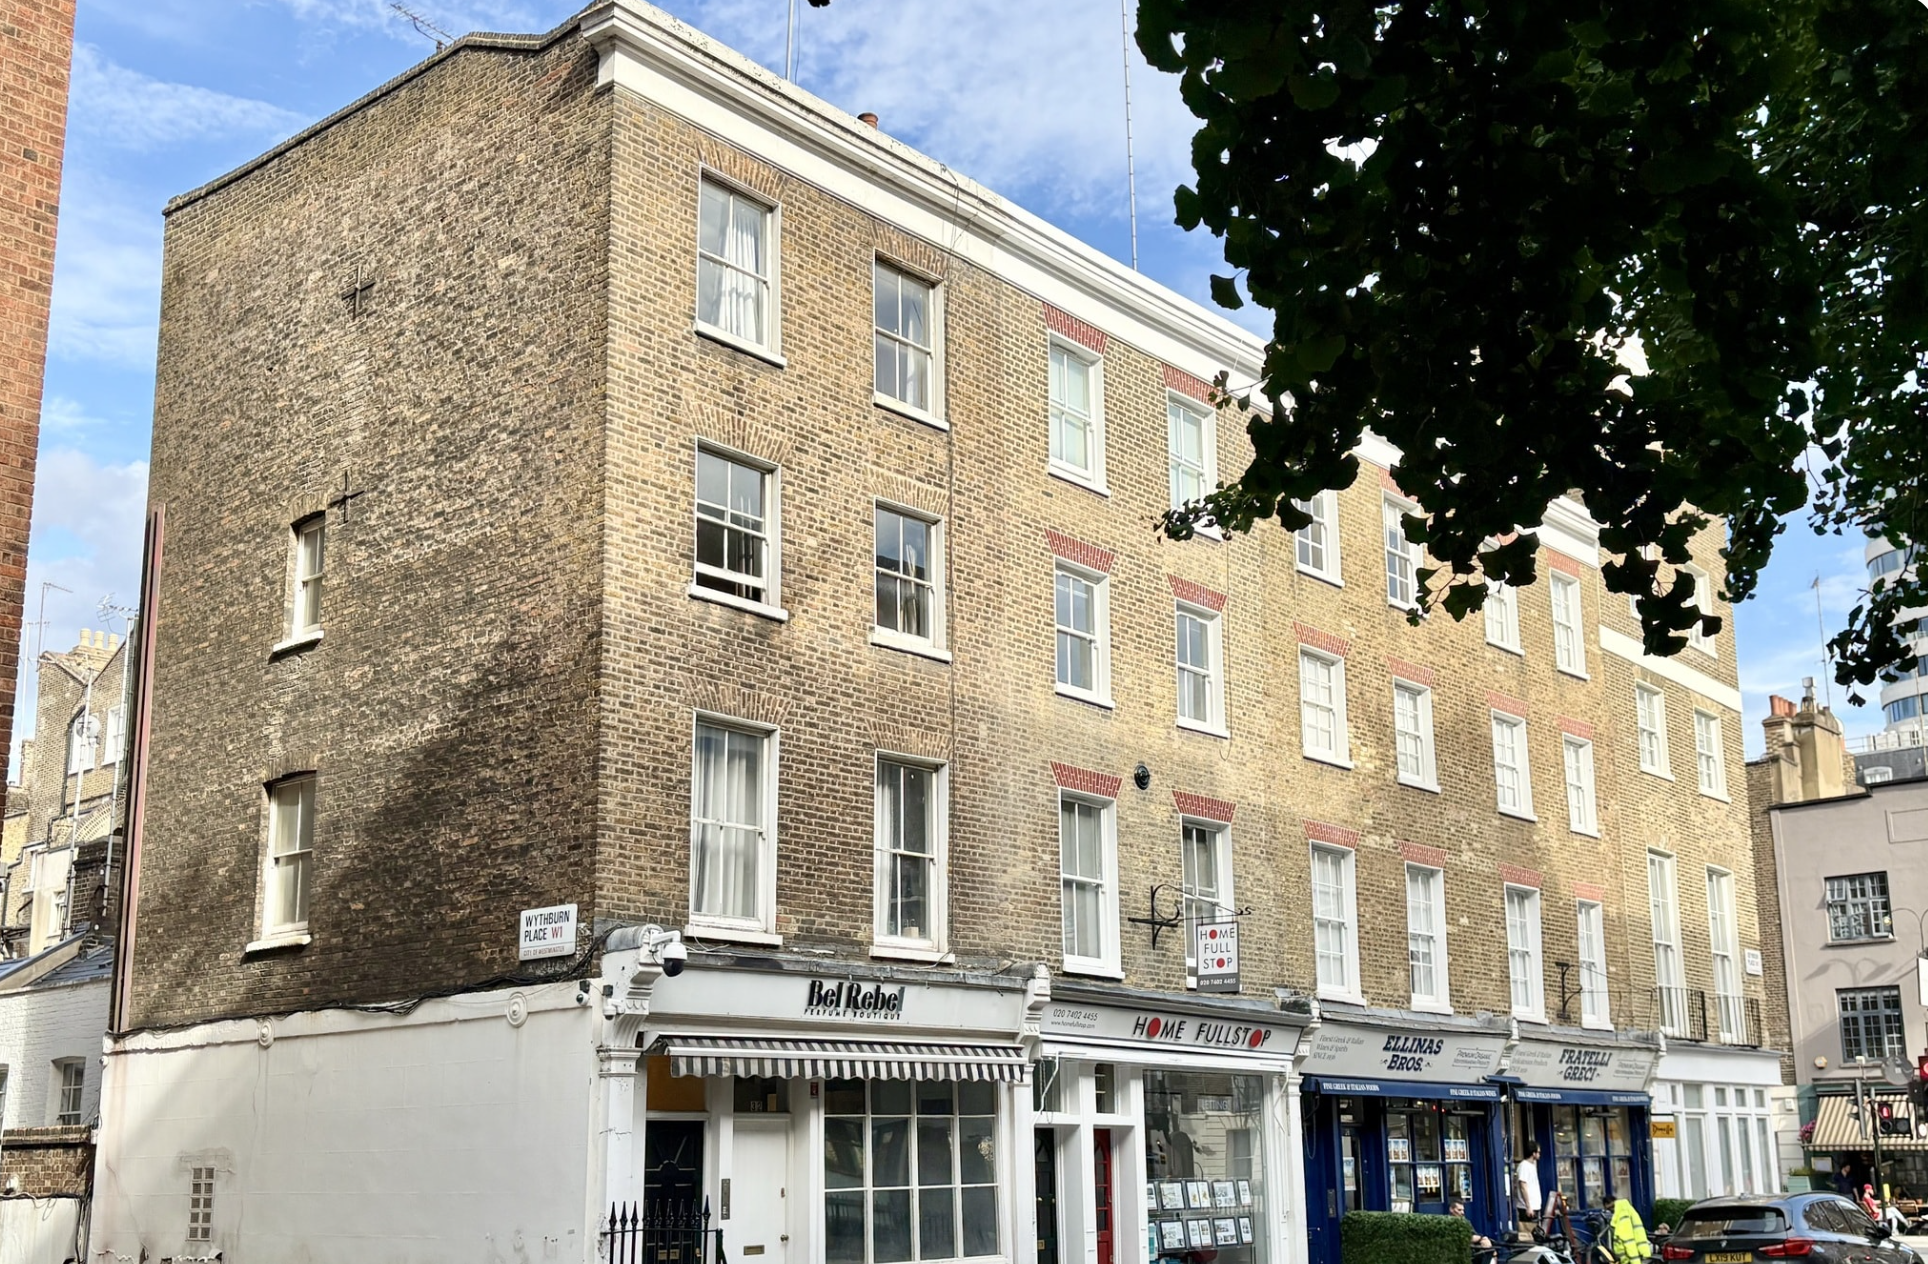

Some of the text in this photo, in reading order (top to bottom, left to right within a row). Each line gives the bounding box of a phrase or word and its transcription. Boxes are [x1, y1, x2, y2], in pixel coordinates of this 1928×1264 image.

[526, 910, 570, 928] WYTHBURN
[524, 926, 563, 942] PLACE W1
[1200, 927, 1235, 940] HOME
[524, 948, 532, 956] CITY
[1204, 942, 1231, 954] FULL
[1203, 956, 1232, 970] STOP
[808, 980, 905, 1012] Bel Rebel
[804, 1008, 900, 1020] PERFUME BOUTIQUE
[1053, 1008, 1098, 1021] 020 7402 4455
[1132, 1016, 1272, 1048] HOME FULLSTOP
[1382, 1035, 1444, 1055] ELLINAS
[1387, 1054, 1423, 1072] BROS.
[1558, 1049, 1612, 1067] FRATELLI
[1564, 1066, 1597, 1081] GRECI
[1710, 1253, 1746, 1262] LX19 KUT
